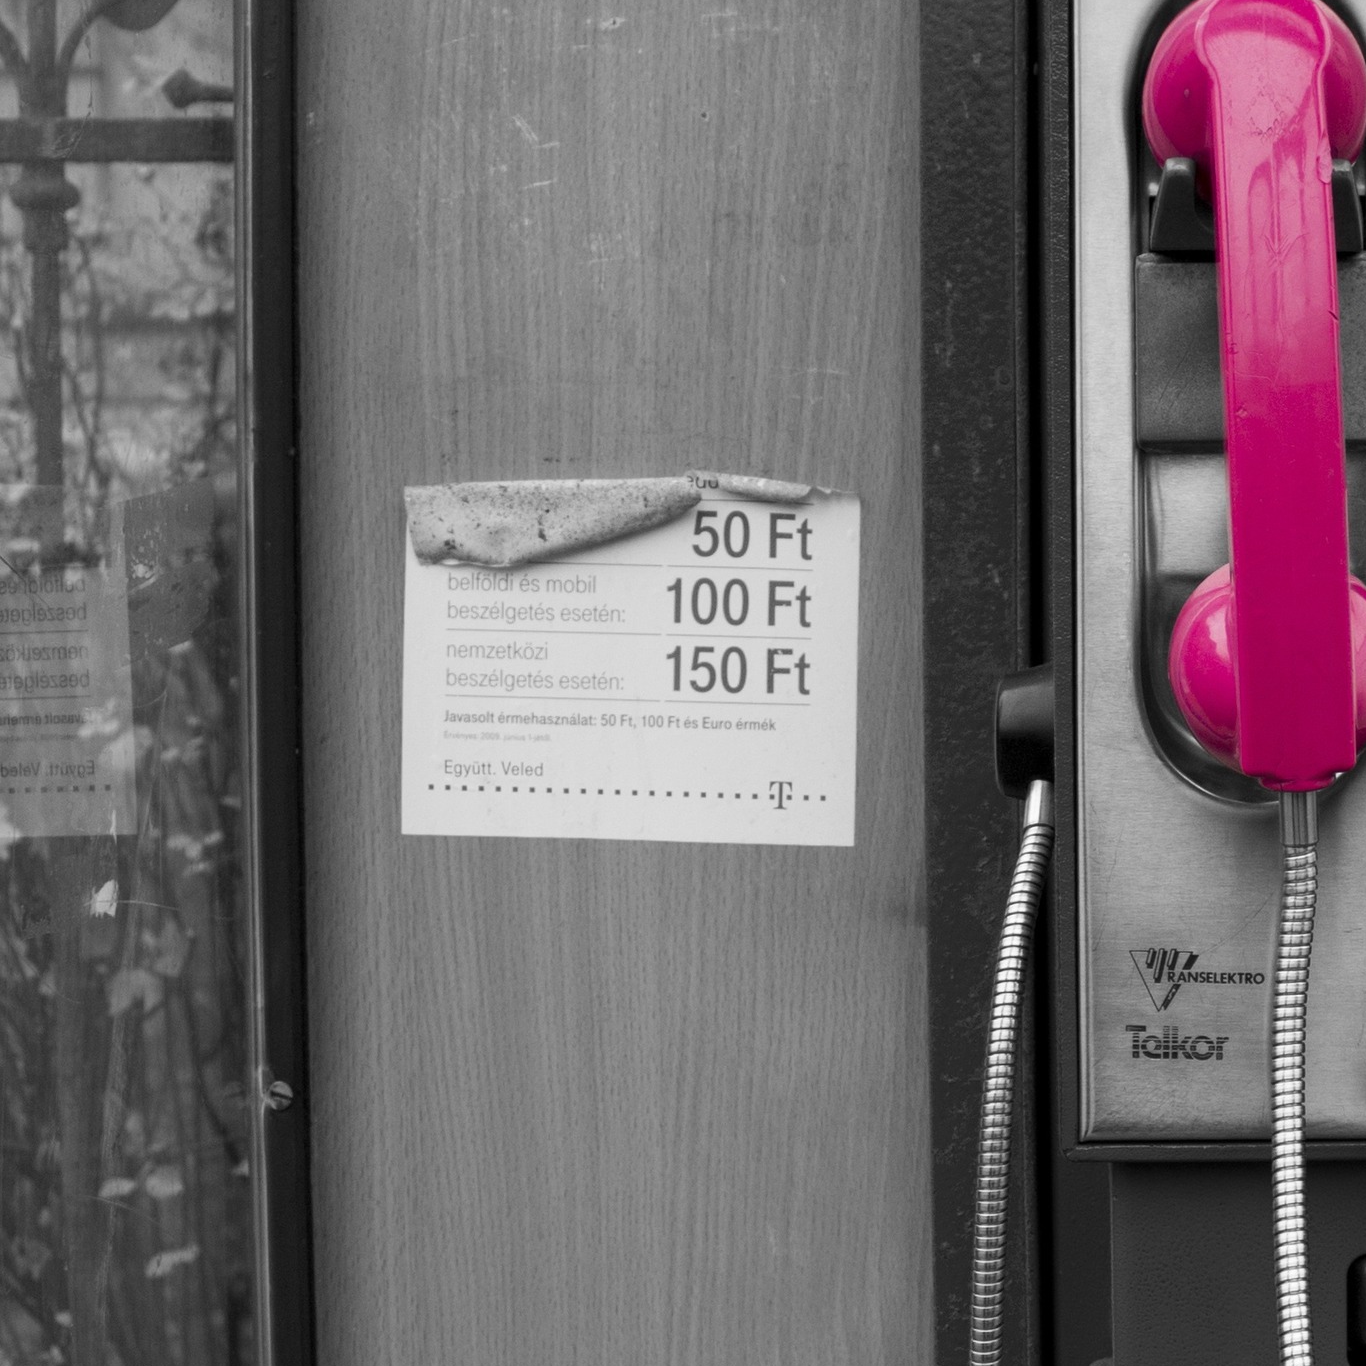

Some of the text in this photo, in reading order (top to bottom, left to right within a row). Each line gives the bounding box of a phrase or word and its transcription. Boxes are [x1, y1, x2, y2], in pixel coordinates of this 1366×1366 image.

[691, 509, 813, 560] 50 Ft
[447, 572, 596, 593] belföldi és mobil
[447, 601, 625, 624] beszélgetés esetén:
[666, 577, 811, 627] 100 Ft
[446, 641, 548, 660] nemzetközi
[445, 668, 624, 691] beszélgetés esetén:
[666, 645, 810, 695] 150 Ft
[443, 710, 776, 731] Javasolt érmehasználat: 50 Ft, 100 Ft és Euro érmék
[443, 759, 544, 777] Együtt. Veled
